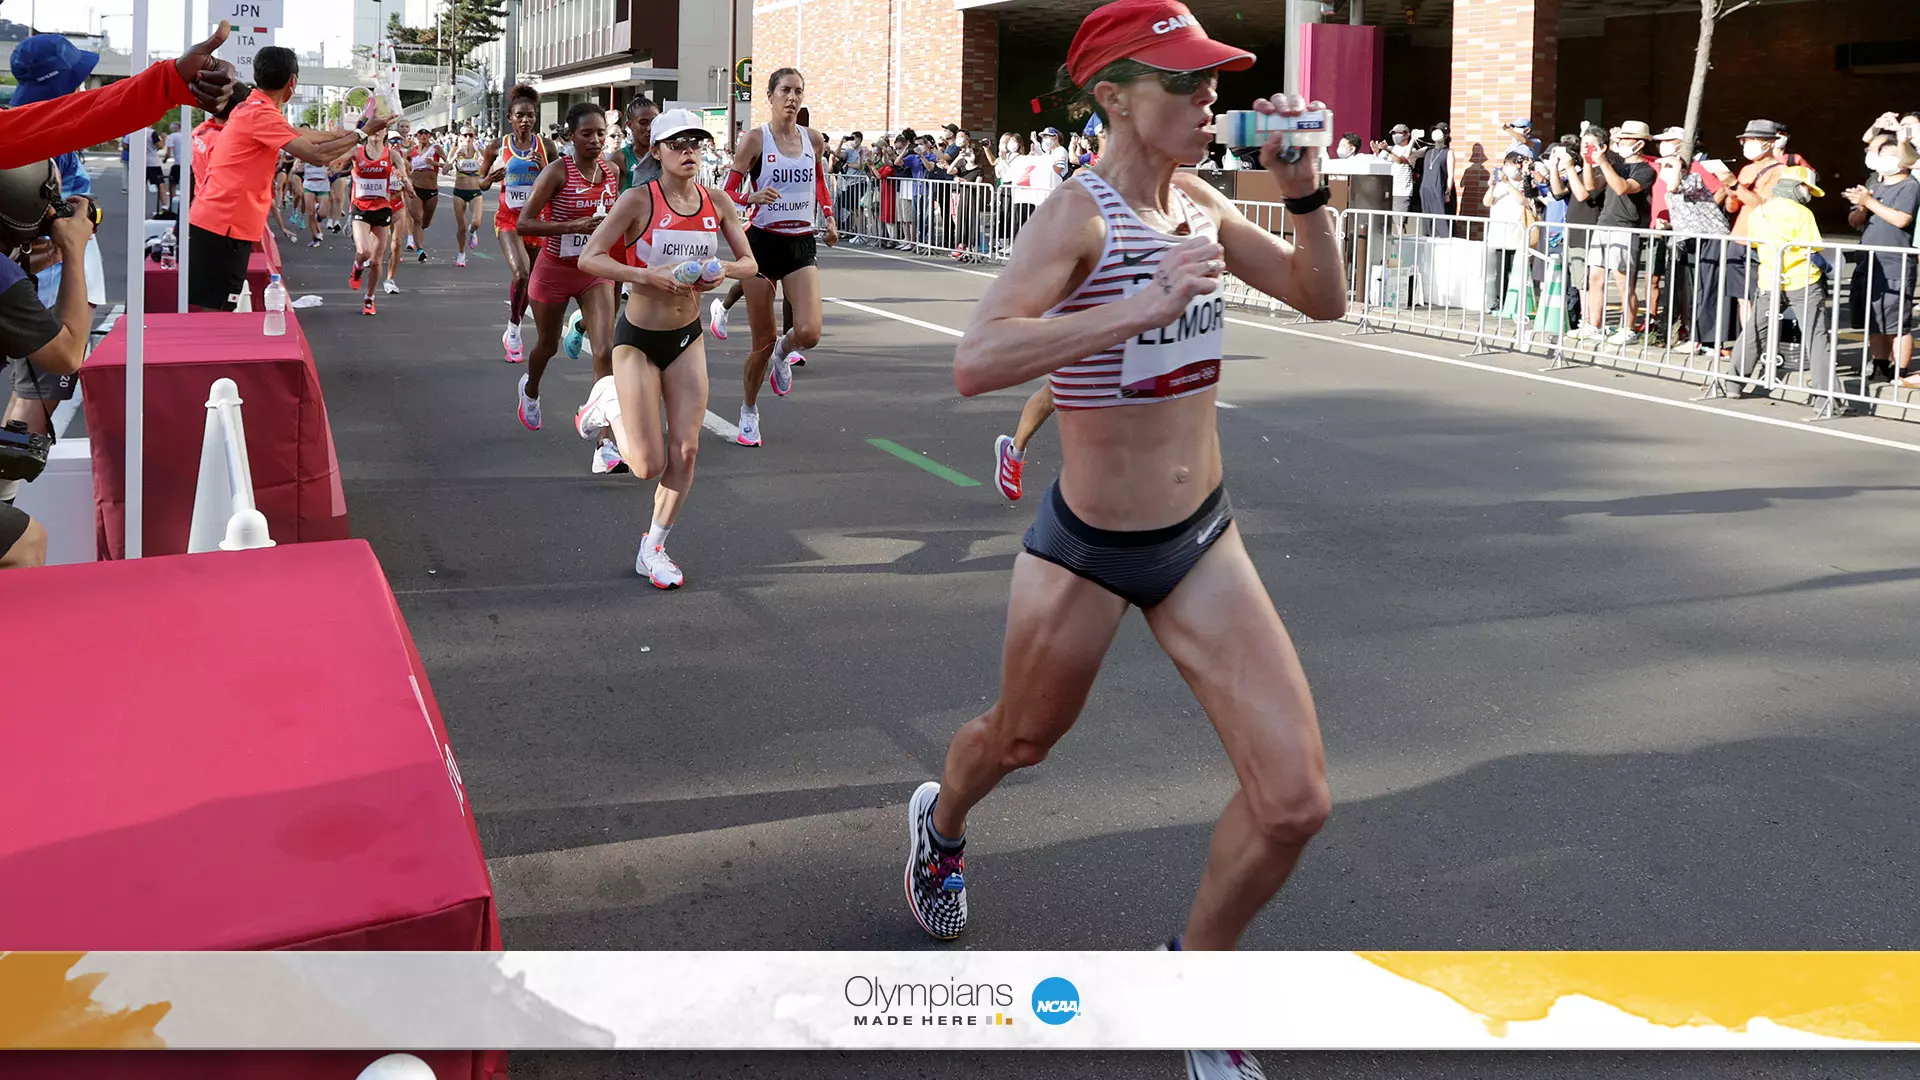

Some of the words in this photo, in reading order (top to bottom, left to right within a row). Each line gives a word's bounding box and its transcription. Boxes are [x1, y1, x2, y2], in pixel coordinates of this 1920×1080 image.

[232, 4, 260, 17] JPN
[237, 36, 255, 46] ITA
[237, 56, 252, 65] ISR
[772, 168, 813, 183] SUISSE
[767, 200, 809, 211] SCHLUMPF
[662, 243, 709, 256] ICHIYAMA
[59, 375, 70, 388] 20
